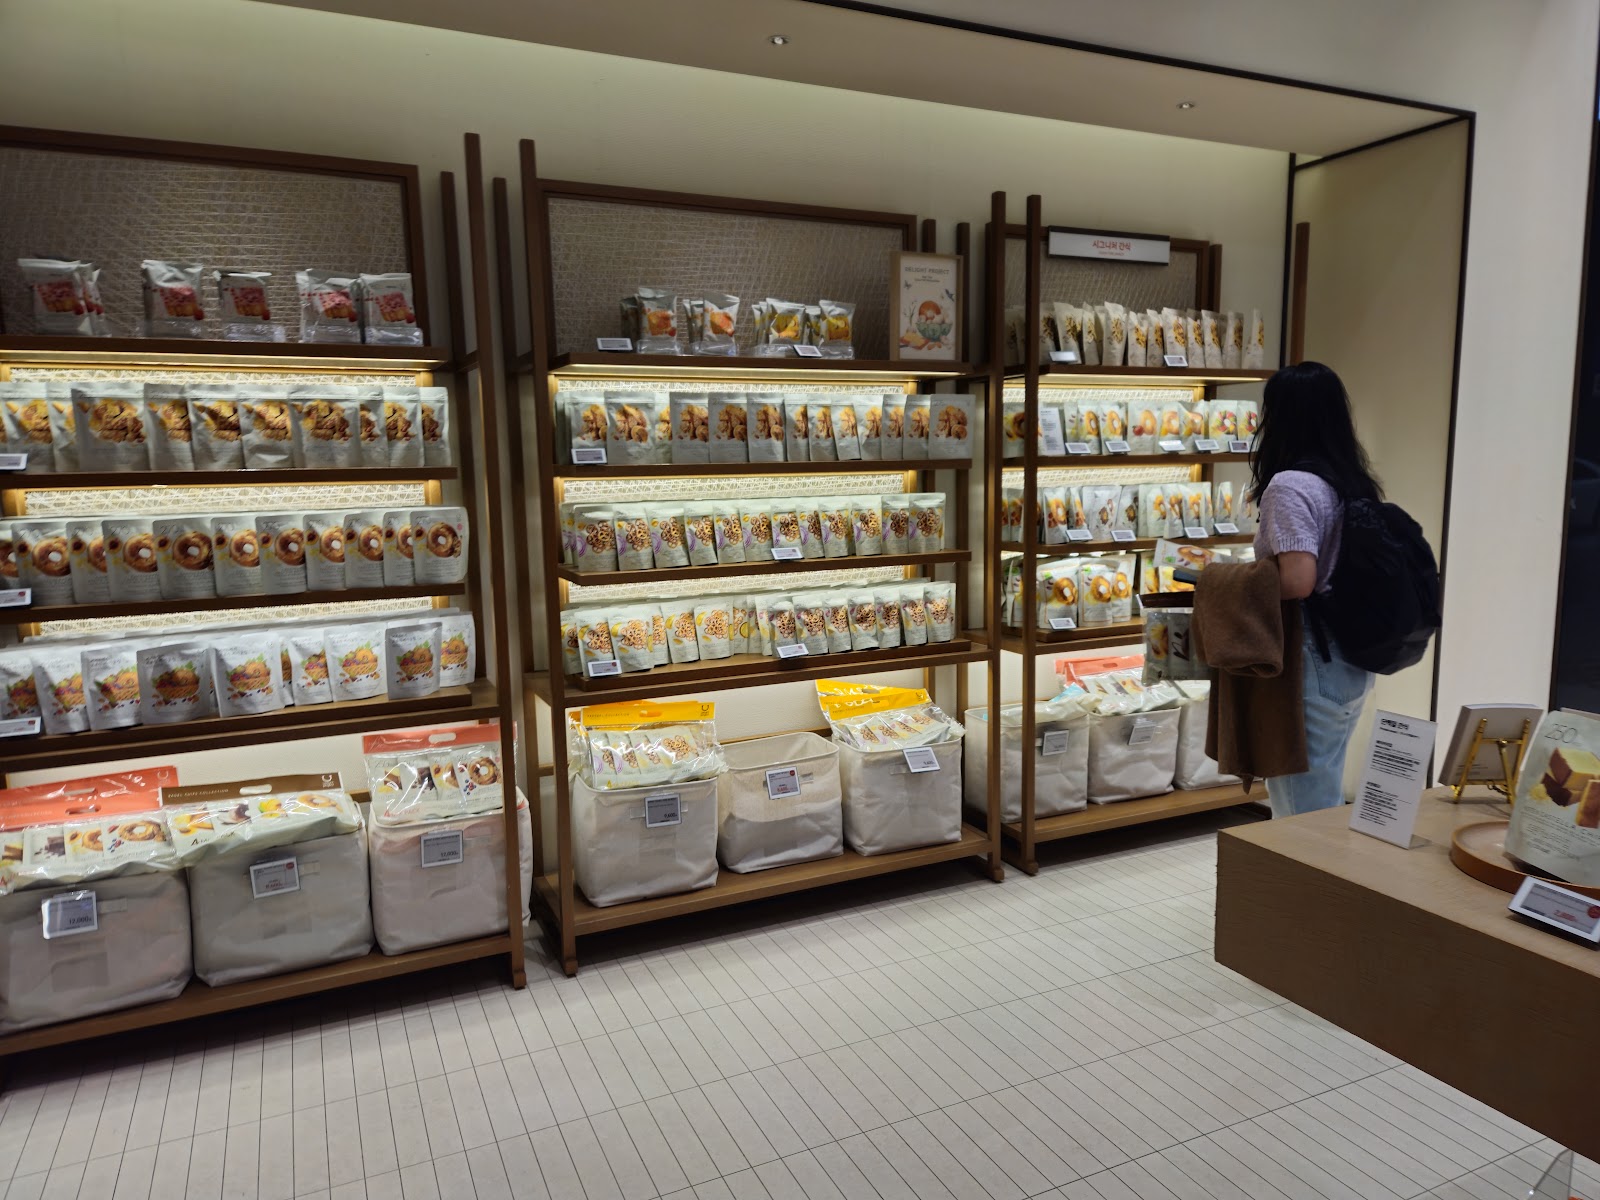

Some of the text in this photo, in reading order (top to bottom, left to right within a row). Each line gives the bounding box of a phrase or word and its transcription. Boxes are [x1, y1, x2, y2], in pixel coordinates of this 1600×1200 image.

[1092, 239, 1131, 251] 시그니처 간식
[928, 267, 950, 275] PROJECT
[1544, 722, 1579, 744] 250
